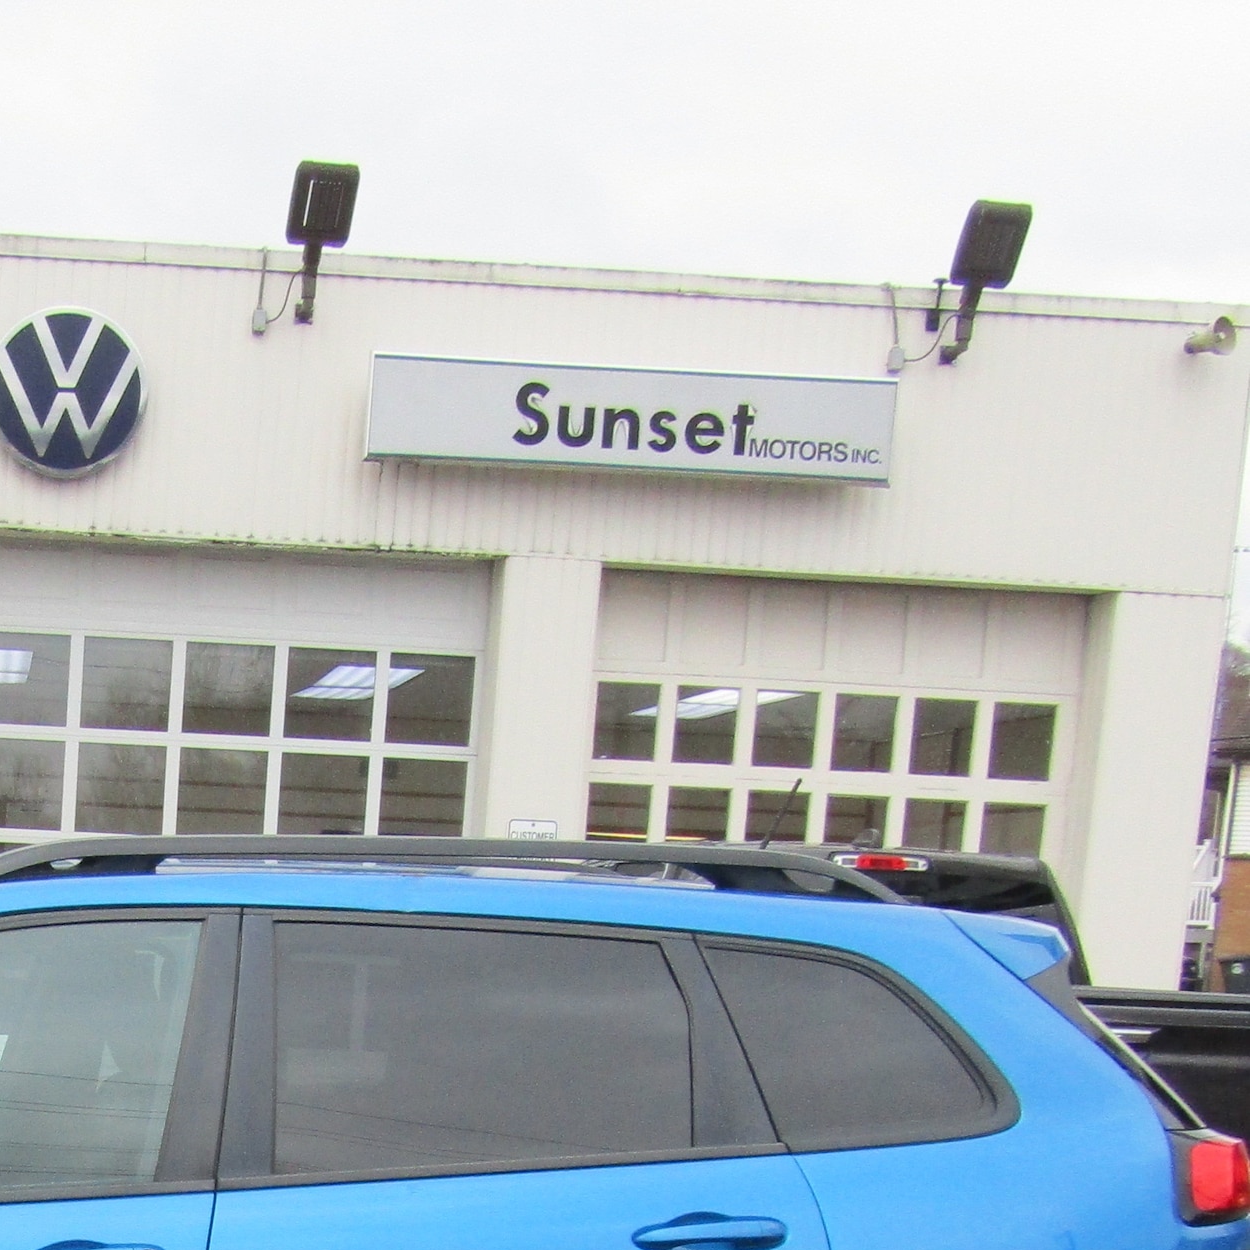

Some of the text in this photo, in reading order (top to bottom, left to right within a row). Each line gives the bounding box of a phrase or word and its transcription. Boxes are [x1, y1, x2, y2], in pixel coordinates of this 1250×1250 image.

[512, 381, 882, 465] Sunset MOTORS INC.
[510, 830, 555, 840] CUSTOMER
